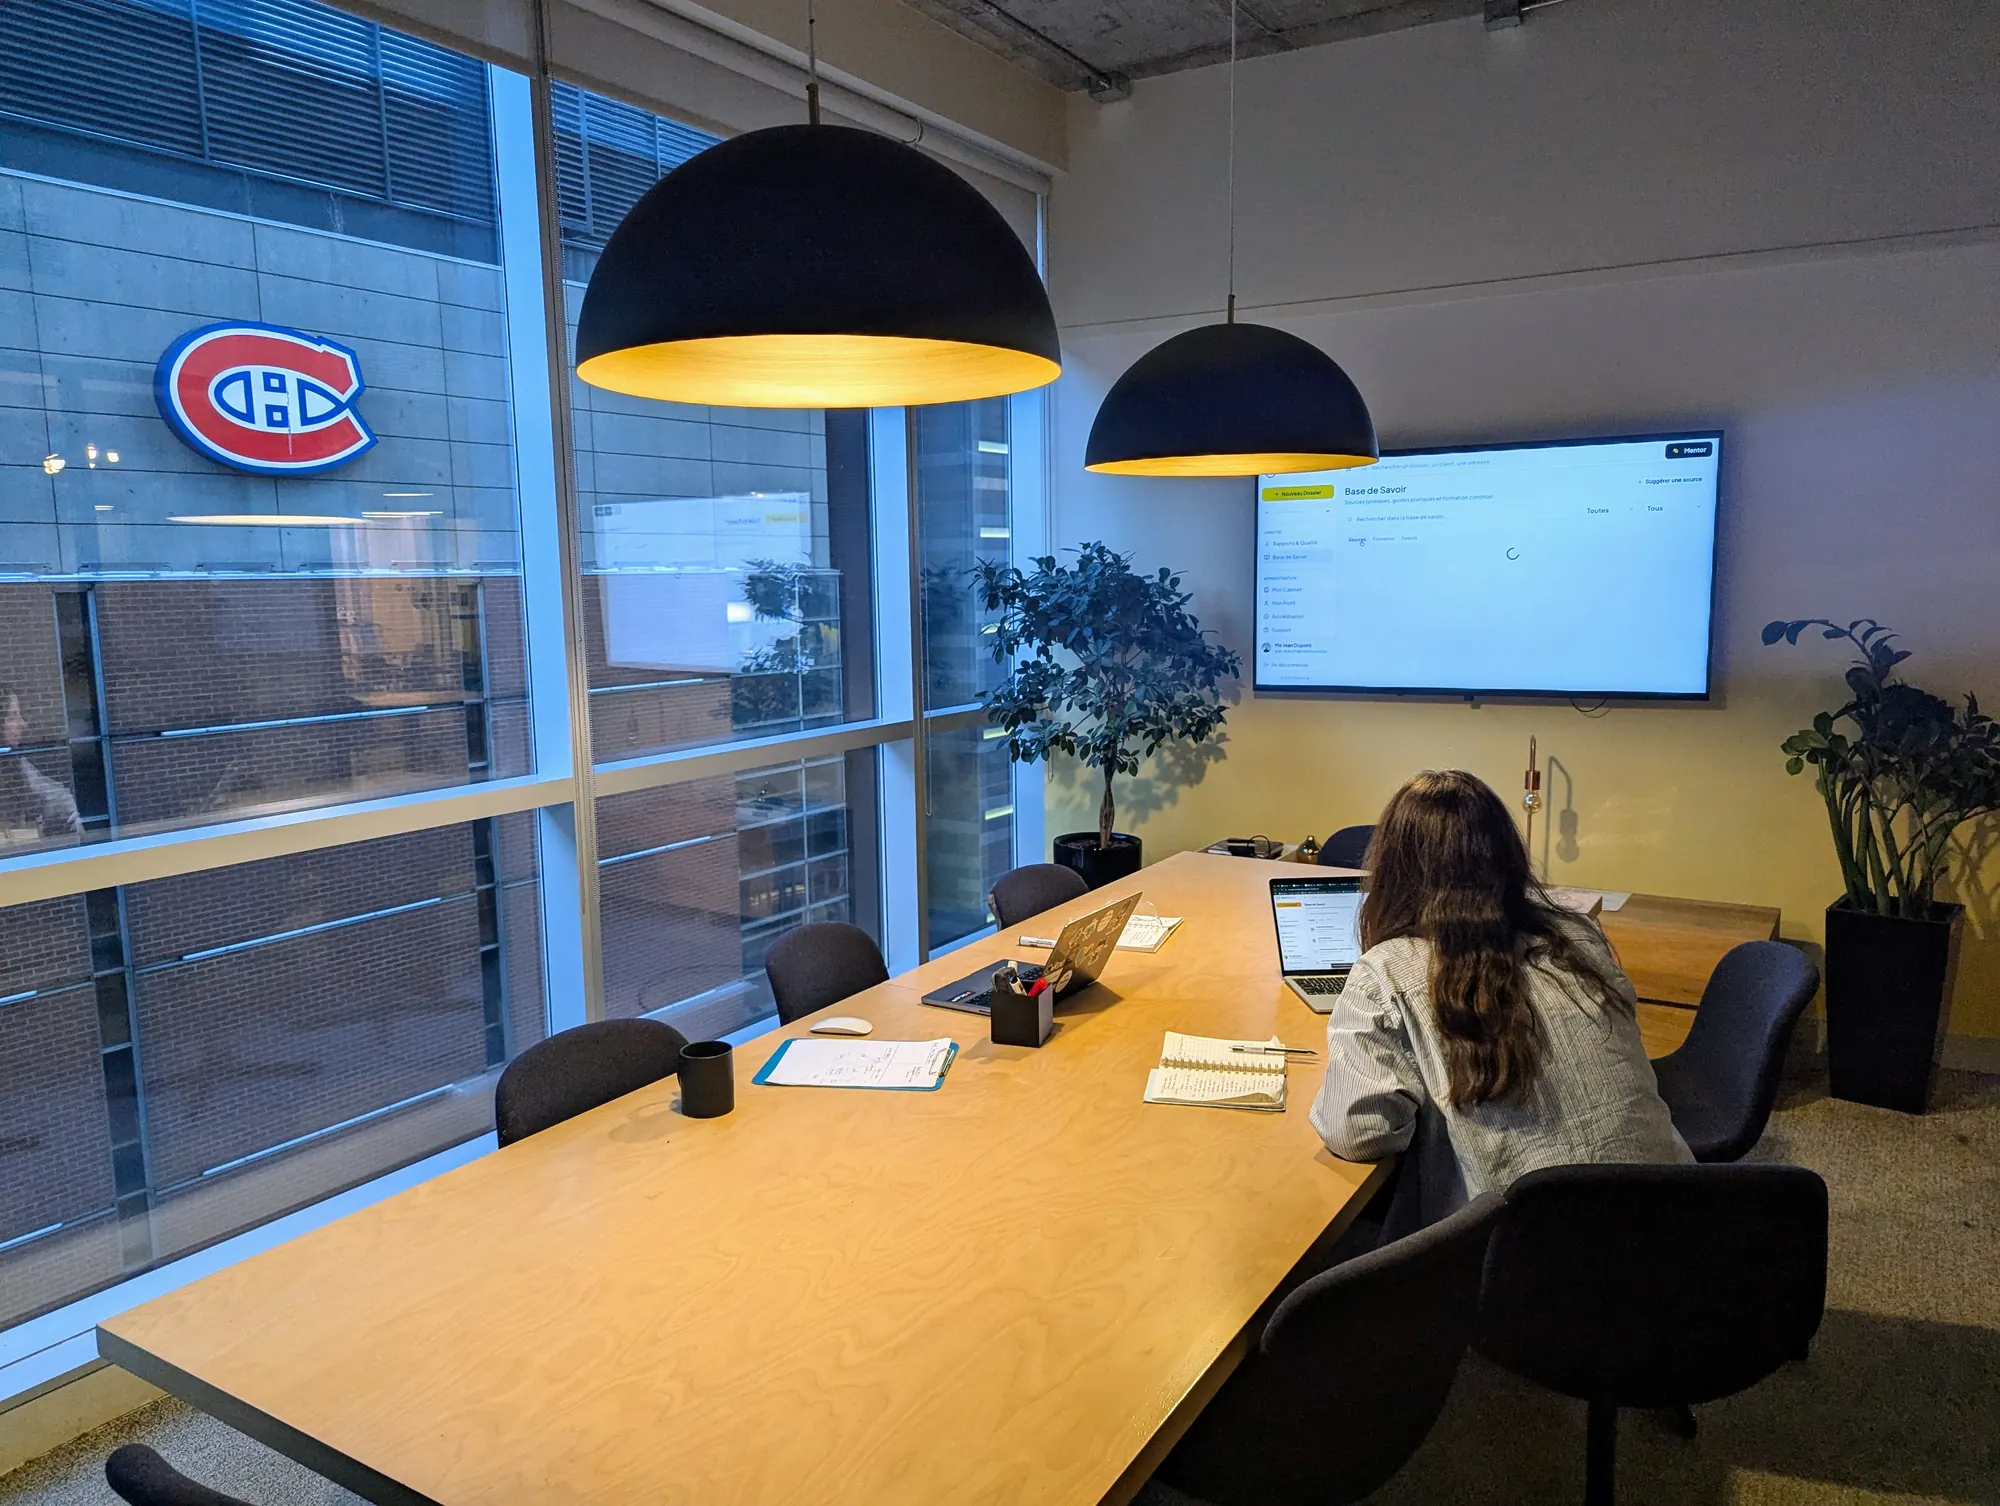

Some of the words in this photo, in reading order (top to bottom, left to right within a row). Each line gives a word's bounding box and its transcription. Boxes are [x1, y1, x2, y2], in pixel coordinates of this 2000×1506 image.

[1683, 446, 1707, 454] Mentor
[1645, 477, 1671, 485] Suggérer
[1344, 487, 1366, 496] Base
[1366, 486, 1379, 495] de
[1379, 485, 1408, 494] Savoir
